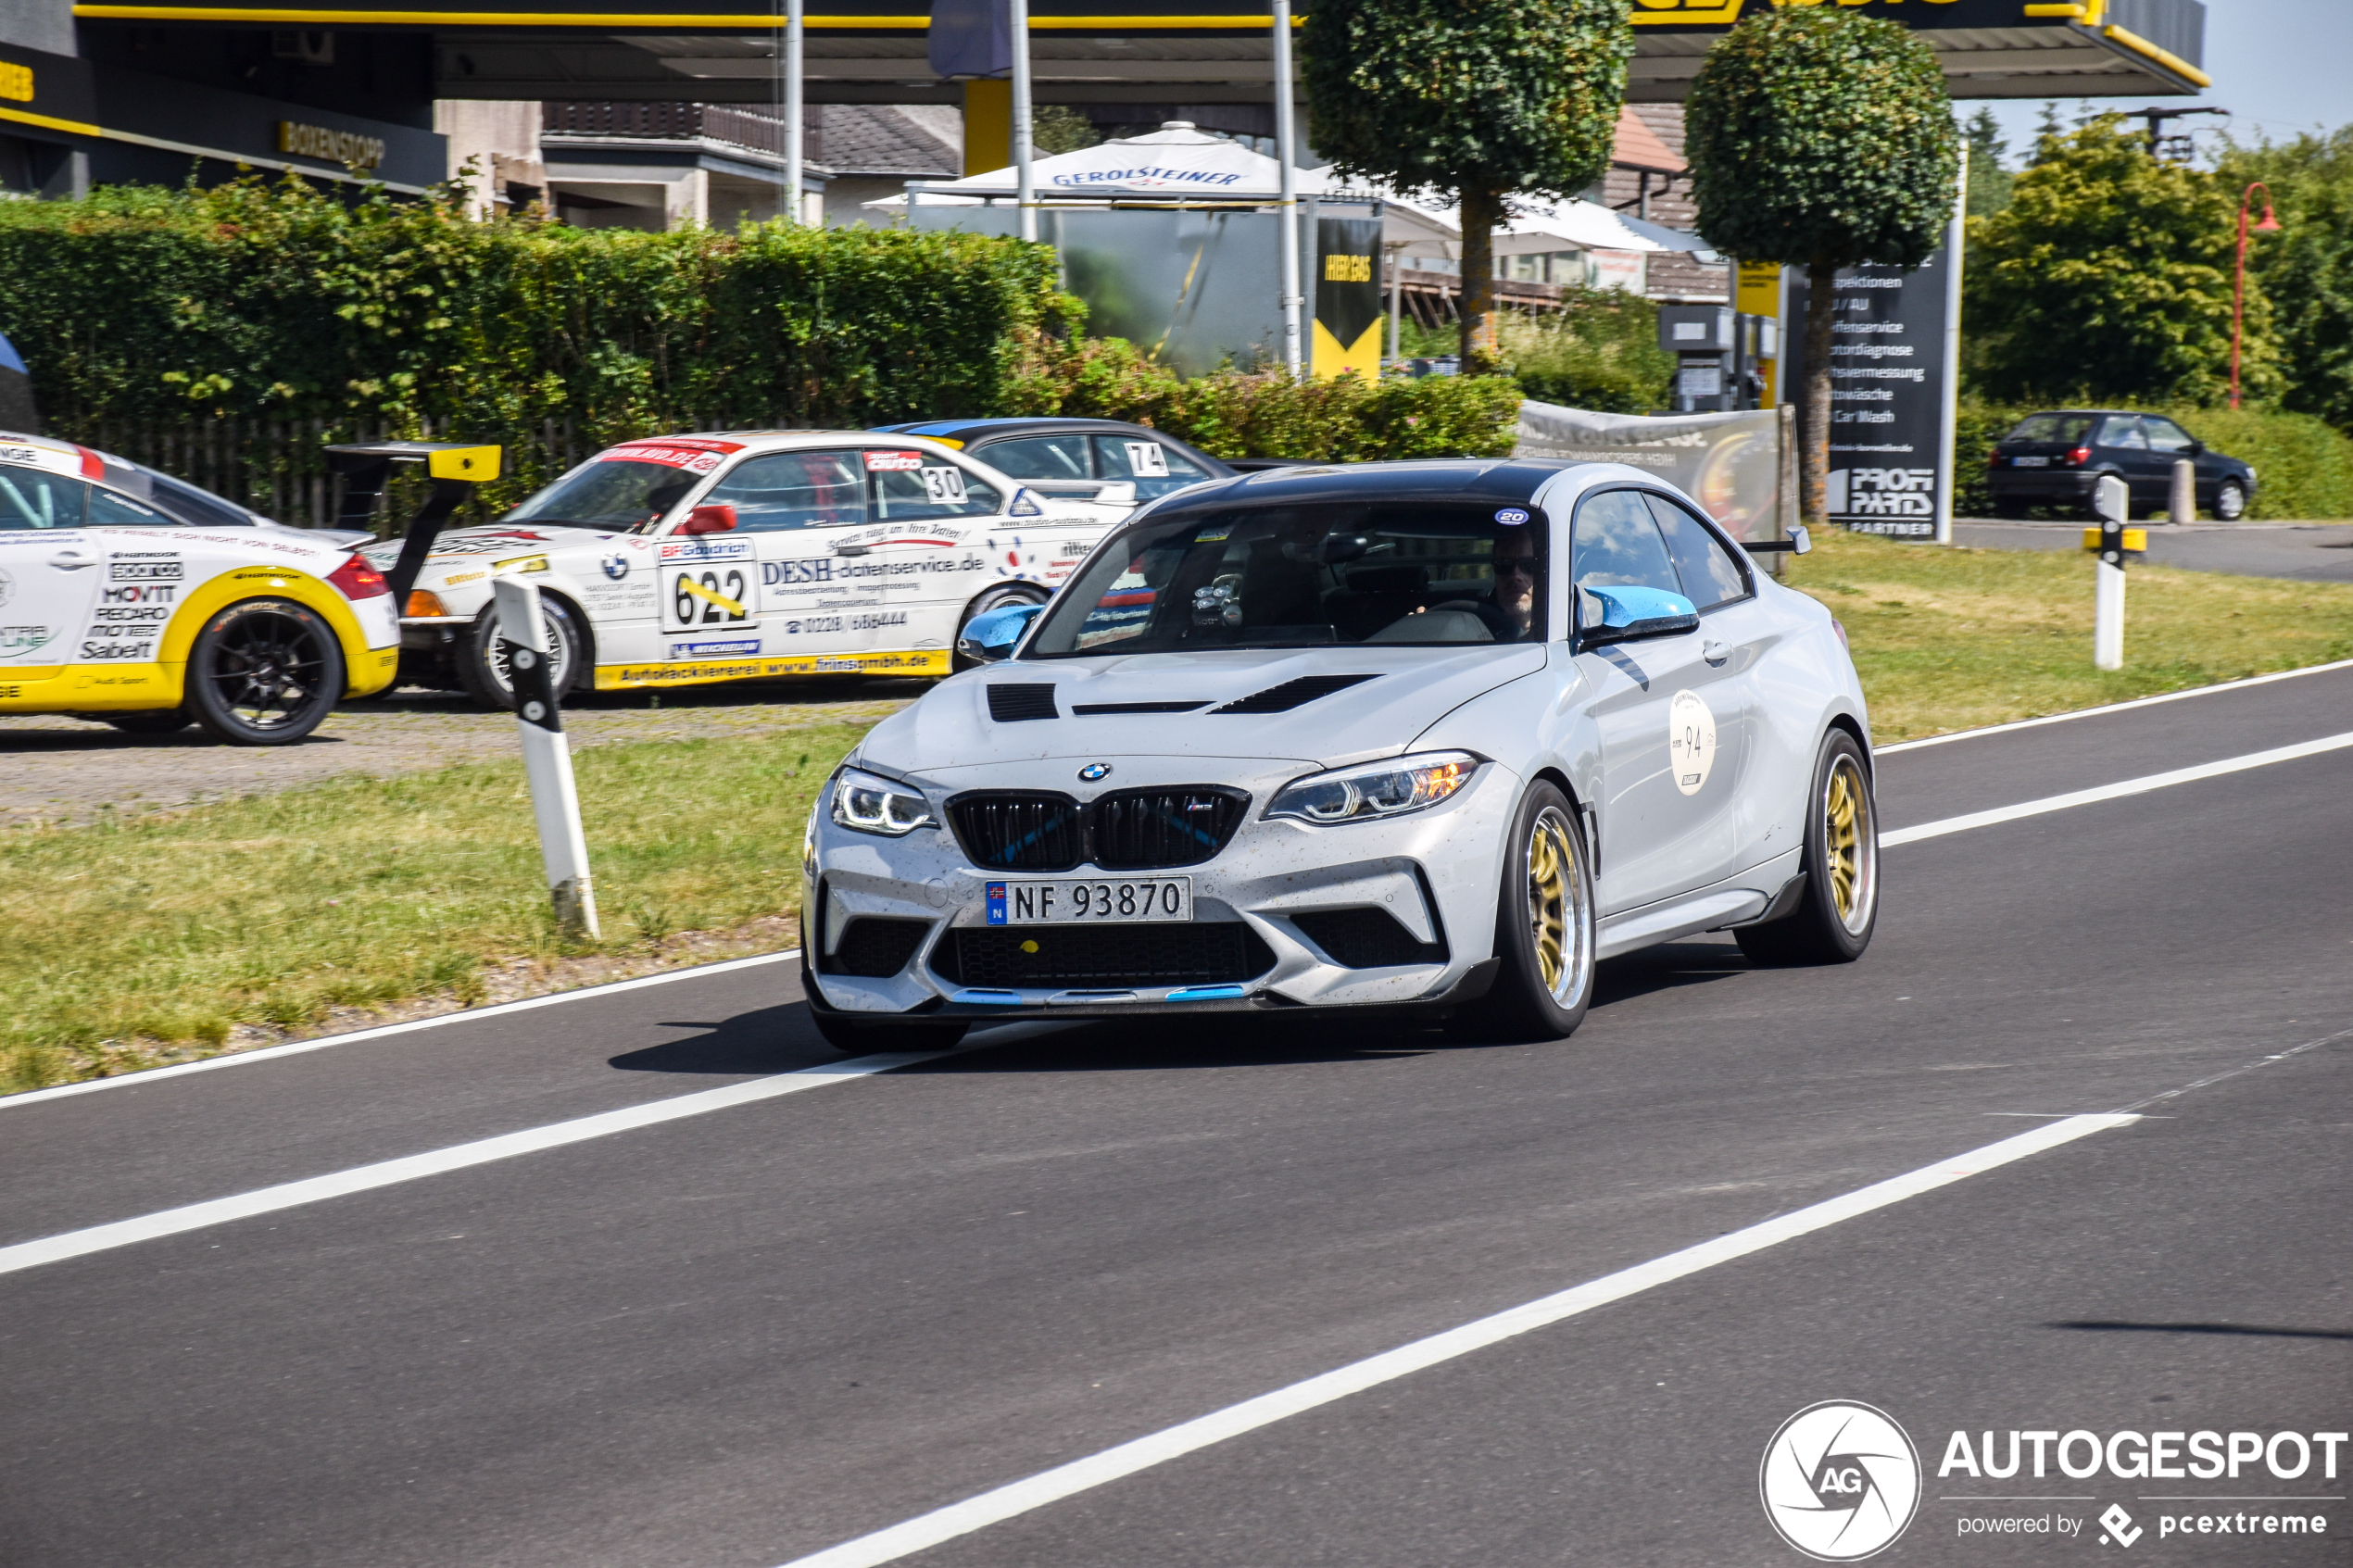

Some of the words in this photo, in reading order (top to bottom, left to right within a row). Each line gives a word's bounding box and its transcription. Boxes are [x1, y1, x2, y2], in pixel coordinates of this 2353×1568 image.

[280, 121, 384, 168] BOXENSTOPP
[1052, 167, 1241, 185] GEROLSTEINER
[1856, 410, 1894, 423] Wash
[867, 458, 923, 470] auto
[1127, 445, 1165, 471] 74
[927, 470, 961, 498] 30
[1851, 468, 1934, 491] PROFI
[1851, 492, 1934, 515] PARTS
[1500, 512, 1525, 521] 20
[1850, 522, 1933, 535] PARTNER
[674, 569, 747, 626] 622
[95, 607, 170, 621] RECARO
[80, 641, 152, 659] Sabelt
[691, 642, 760, 654] MICHELIN
[1686, 724, 1702, 759] 94
[993, 909, 1002, 919] N
[1015, 886, 1054, 919] NF
[1073, 883, 1181, 917] 93870
